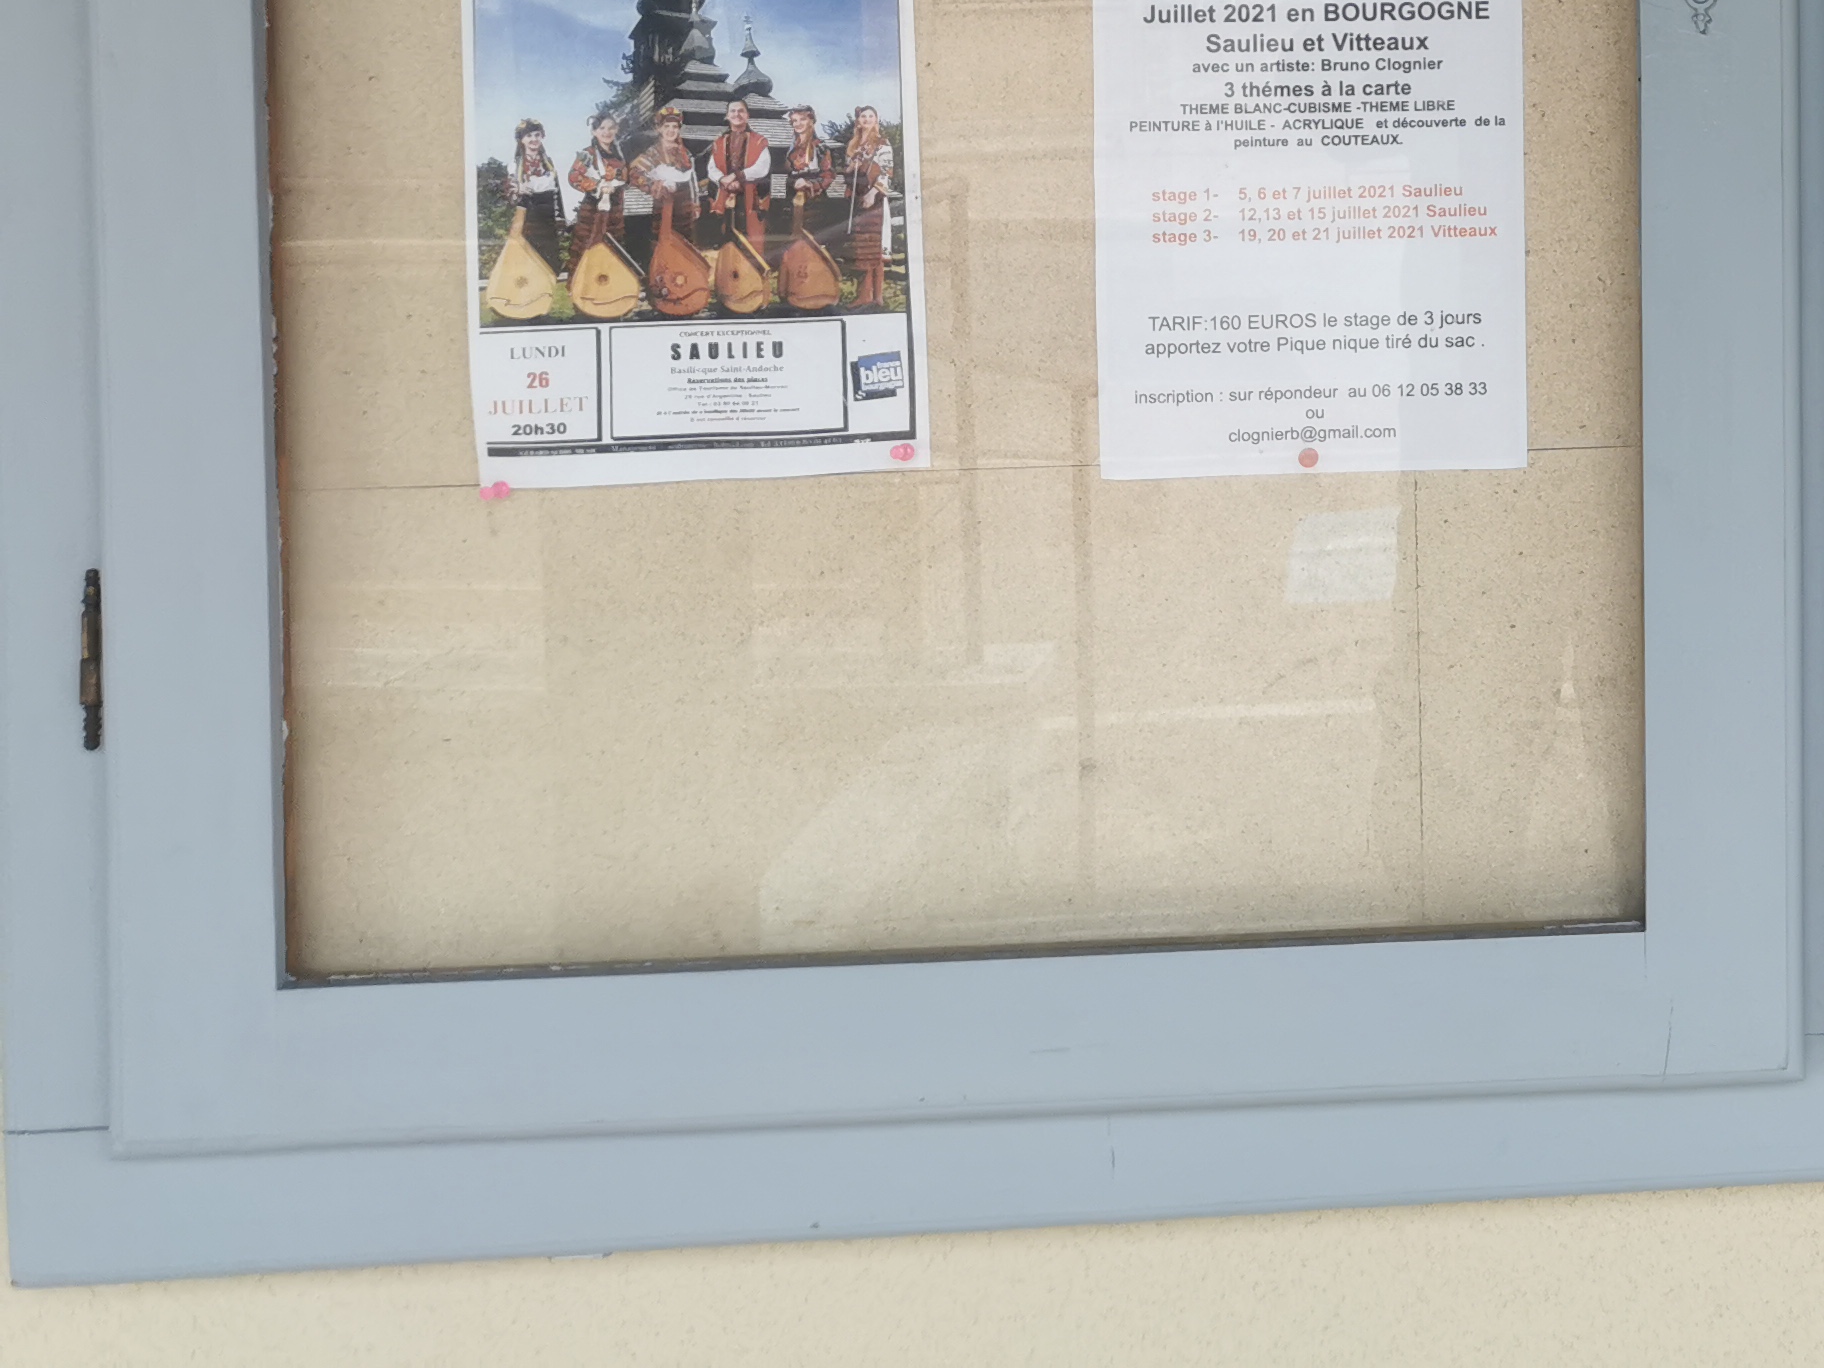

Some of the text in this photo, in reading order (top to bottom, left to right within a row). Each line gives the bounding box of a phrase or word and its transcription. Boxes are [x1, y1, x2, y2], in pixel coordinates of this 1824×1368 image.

[1143, 1, 1490, 24] Juillet 2021 en BOURGOGNE
[1206, 32, 1430, 53] Saulieu et Vitteaux
[1192, 58, 1443, 74] avec un artiste: Bruno Clognier
[1180, 103, 1230, 115] THEME
[1234, 102, 1352, 114] BLANC-CUBISME
[1414, 100, 1456, 112] LIBRE
[509, 344, 567, 361] LUNDI
[670, 340, 785, 361] SAULIEU
[526, 371, 550, 390] 26
[859, 364, 902, 384] bleu
[488, 395, 589, 416] JUILLET
[511, 422, 568, 437] 20h30
[1228, 425, 1397, 444] clognierb@gmail.com
